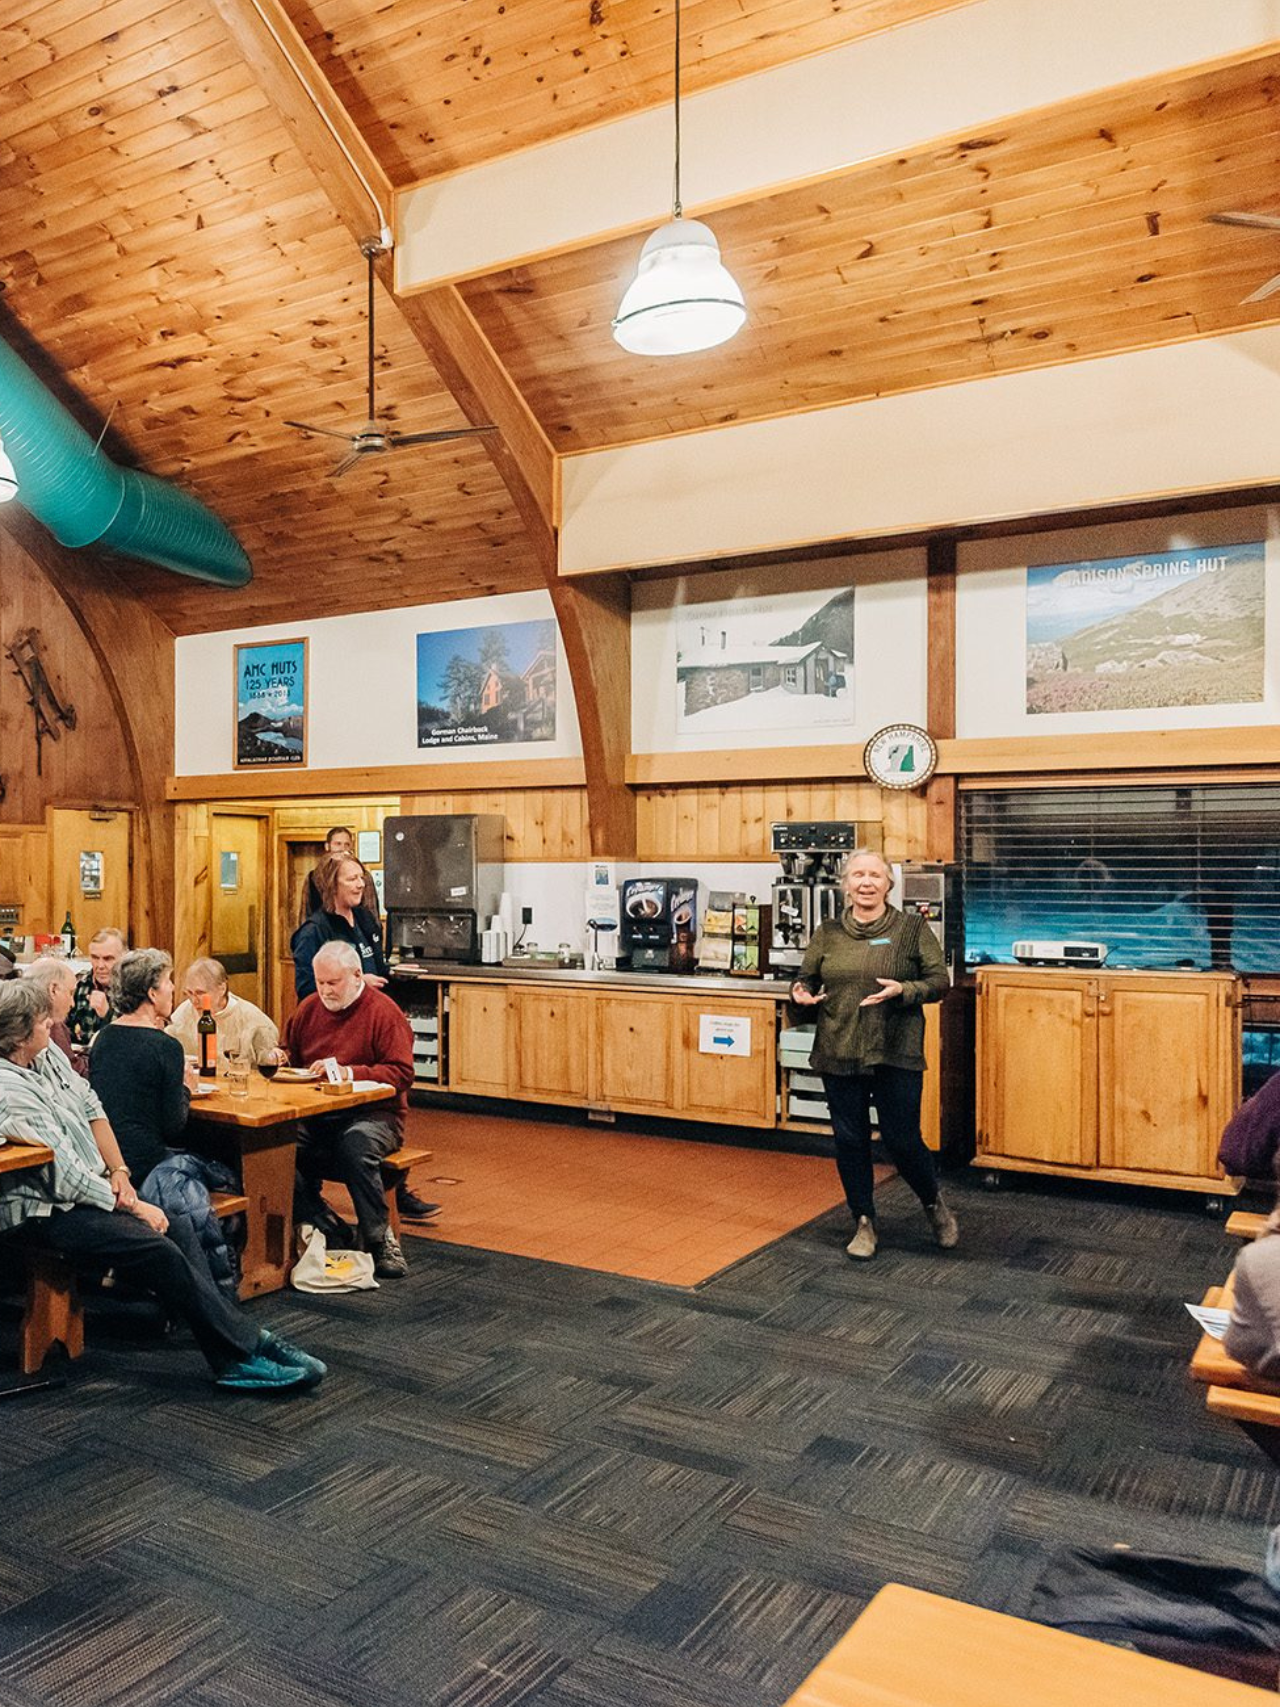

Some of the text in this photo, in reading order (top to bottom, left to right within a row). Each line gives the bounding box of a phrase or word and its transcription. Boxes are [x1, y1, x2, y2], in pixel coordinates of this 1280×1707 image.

[1070, 556, 1227, 586] ADISON SPRING HUT
[244, 660, 298, 678] AMC HUTS
[246, 676, 295, 690] 125 YEARS
[431, 725, 488, 736] Gorman Chairback
[422, 733, 499, 745] Lodge and Cabins, Maine
[873, 731, 928, 753] NEW HAMPSHIRE
